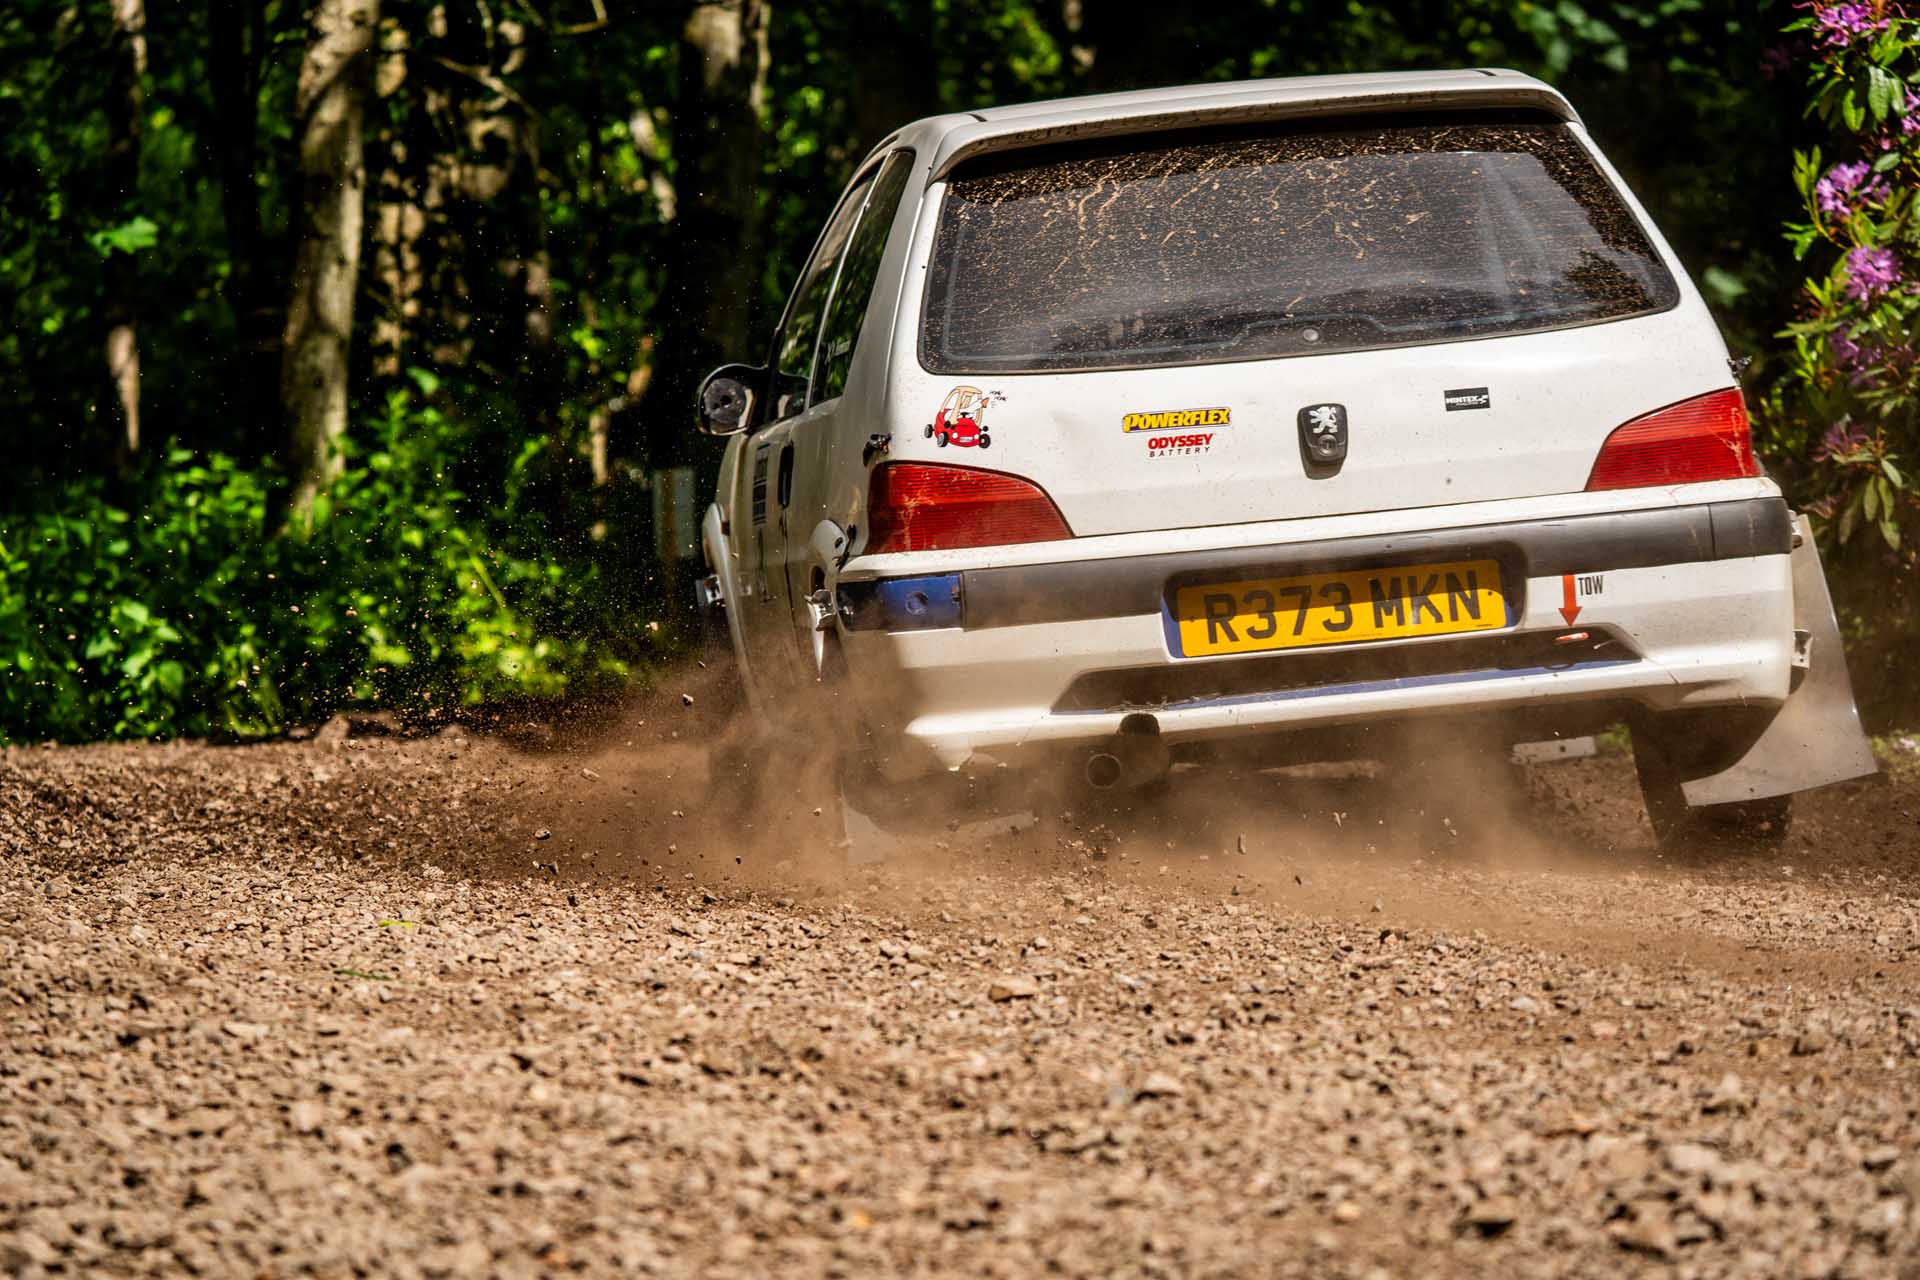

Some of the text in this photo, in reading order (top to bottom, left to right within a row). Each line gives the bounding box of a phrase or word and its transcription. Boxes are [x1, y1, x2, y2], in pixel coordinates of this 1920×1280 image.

[1122, 408, 1230, 432] POWERFLEX
[1148, 433, 1213, 449] ODYSSEY
[1149, 447, 1210, 457] BATTERY
[1578, 575, 1603, 596] TOW
[1204, 569, 1482, 644] R373 MKN
